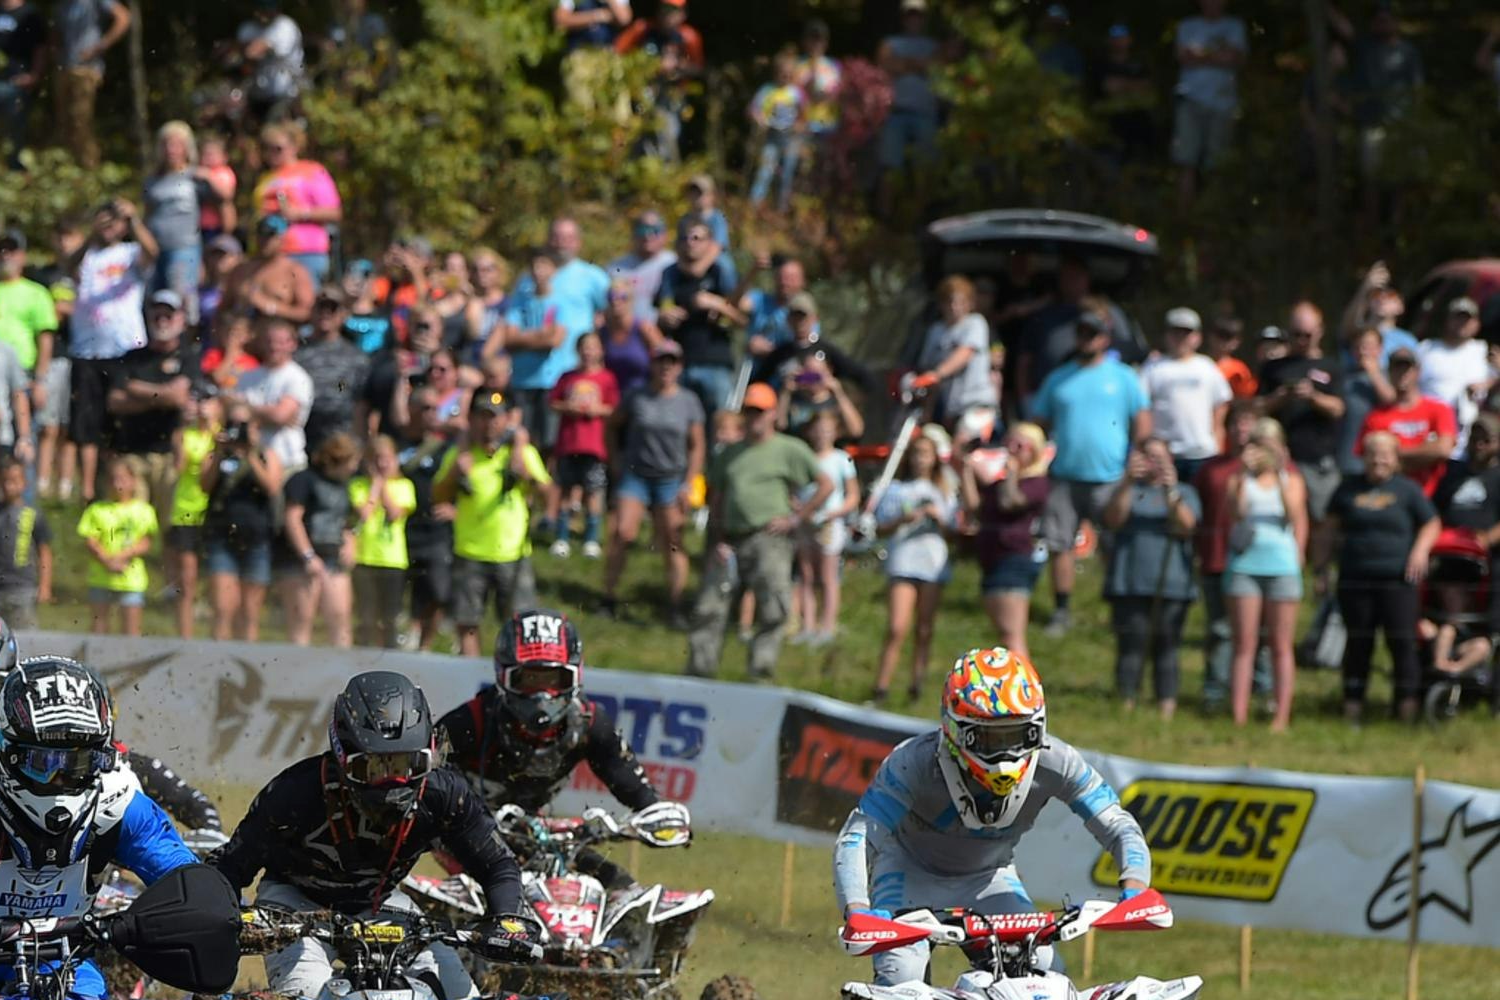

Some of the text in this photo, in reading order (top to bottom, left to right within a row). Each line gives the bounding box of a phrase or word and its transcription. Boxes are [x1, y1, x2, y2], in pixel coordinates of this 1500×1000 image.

[522, 615, 562, 638] FLY
[35, 671, 88, 699] FLY
[3, 894, 63, 910] YAMAHA
